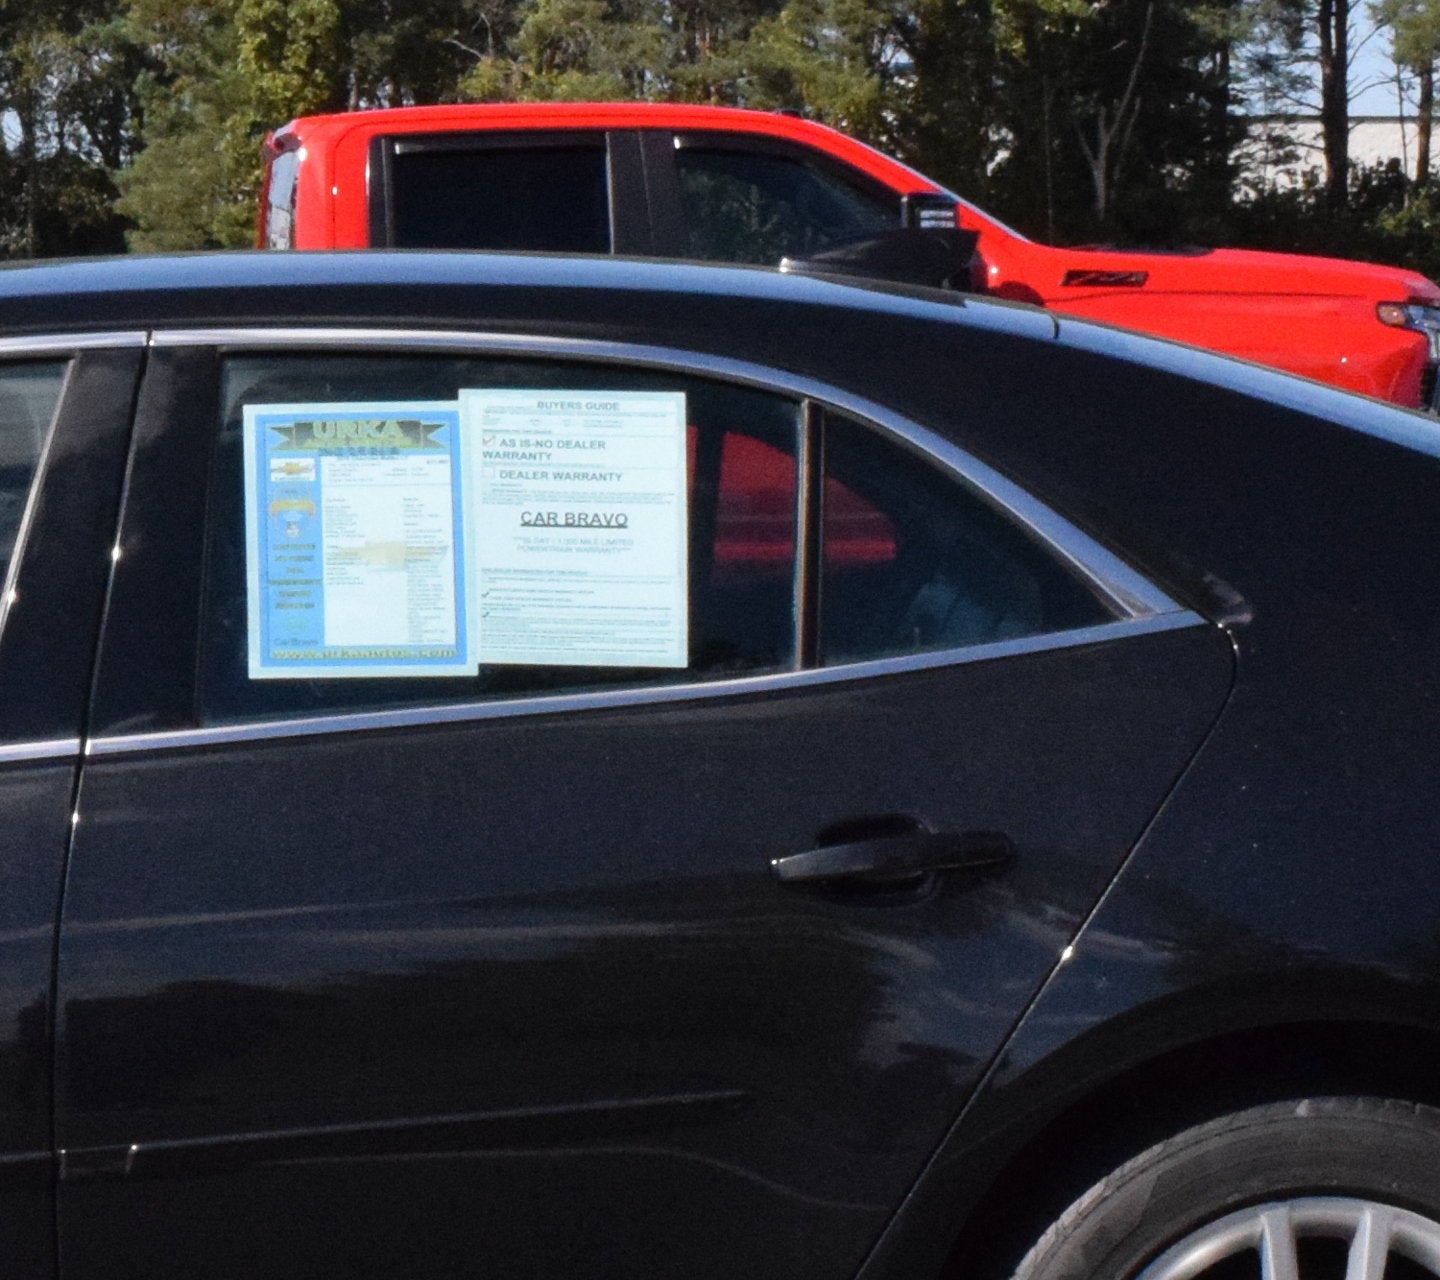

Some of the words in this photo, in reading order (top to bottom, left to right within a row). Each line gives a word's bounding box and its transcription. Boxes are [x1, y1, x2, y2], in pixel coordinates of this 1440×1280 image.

[537, 401, 582, 410] BUYERS
[585, 401, 620, 411] GUIDE
[313, 420, 404, 439] URKA
[499, 438, 516, 448] AS
[557, 439, 606, 449] DEALER
[482, 450, 552, 461] WARRANTY
[499, 469, 549, 480] DEALER
[552, 470, 622, 481] WARRANTY
[521, 511, 558, 526] CAR
[564, 511, 628, 527] BRAVO
